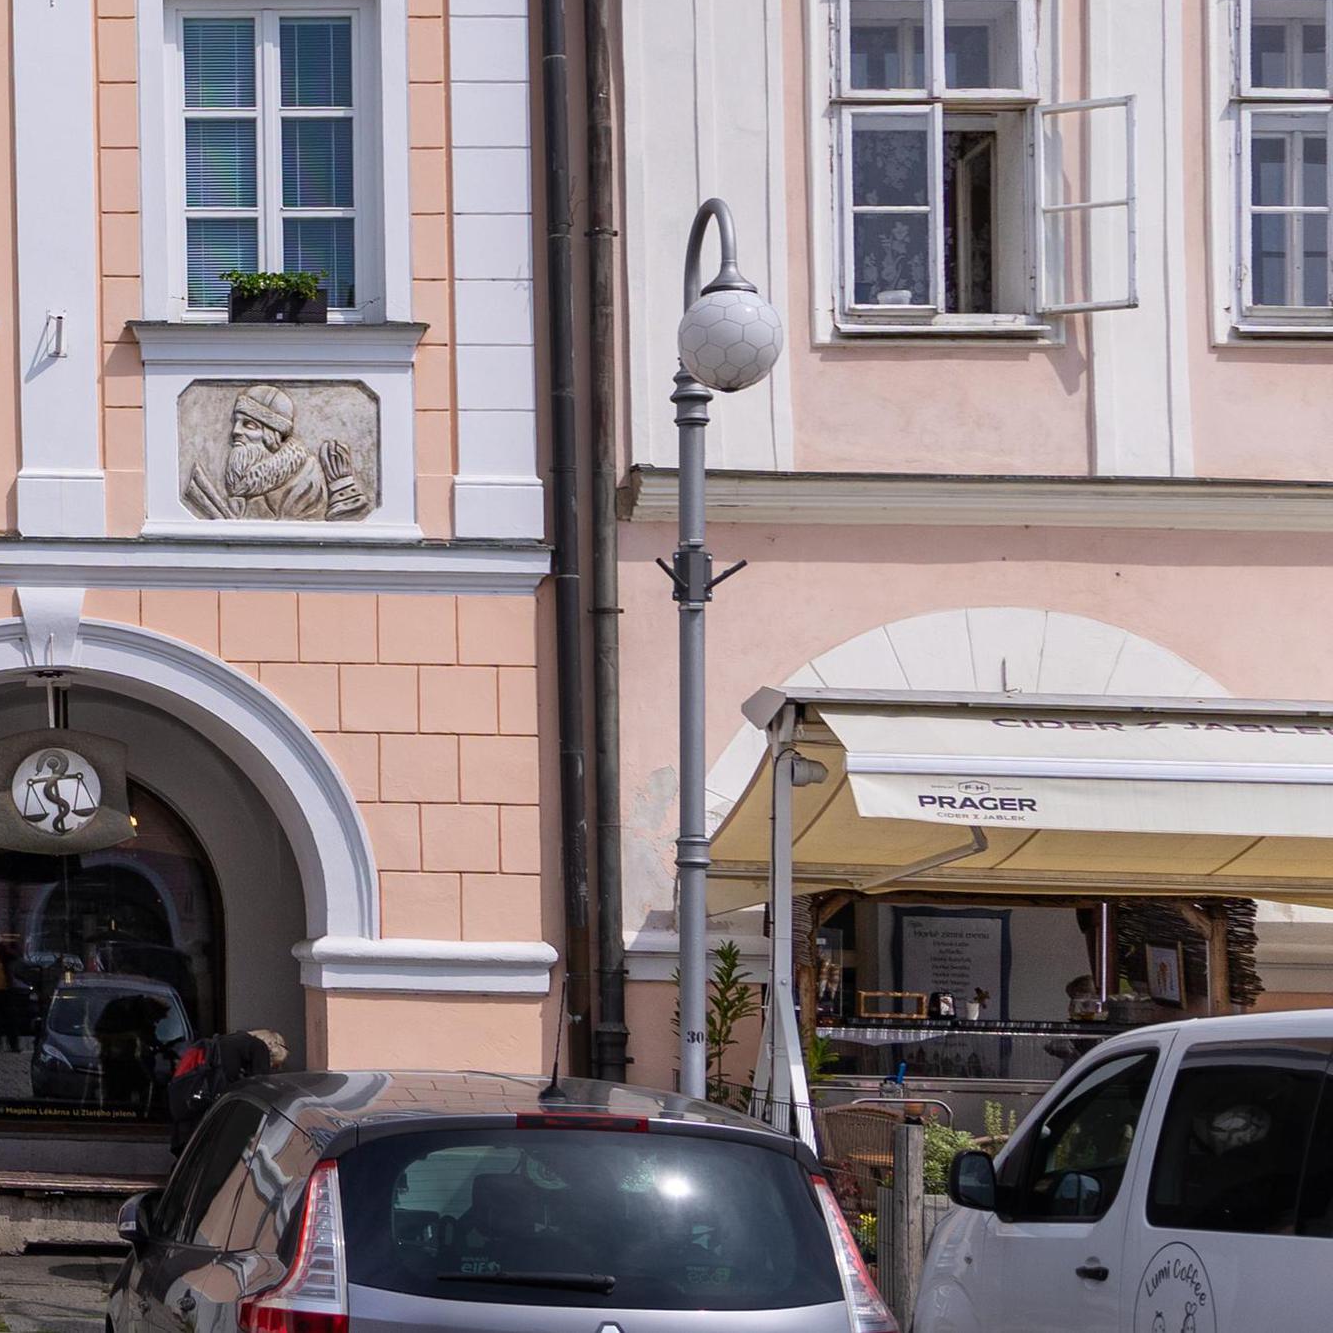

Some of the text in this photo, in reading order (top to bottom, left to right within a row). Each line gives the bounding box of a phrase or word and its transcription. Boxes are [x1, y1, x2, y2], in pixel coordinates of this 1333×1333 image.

[992, 718, 1127, 731] CIDER
[1137, 721, 1168, 730] Z
[918, 795, 1037, 812] PRAGER
[687, 1031, 704, 1043] 30
[1145, 1258, 1207, 1306] Lumi Coffee
